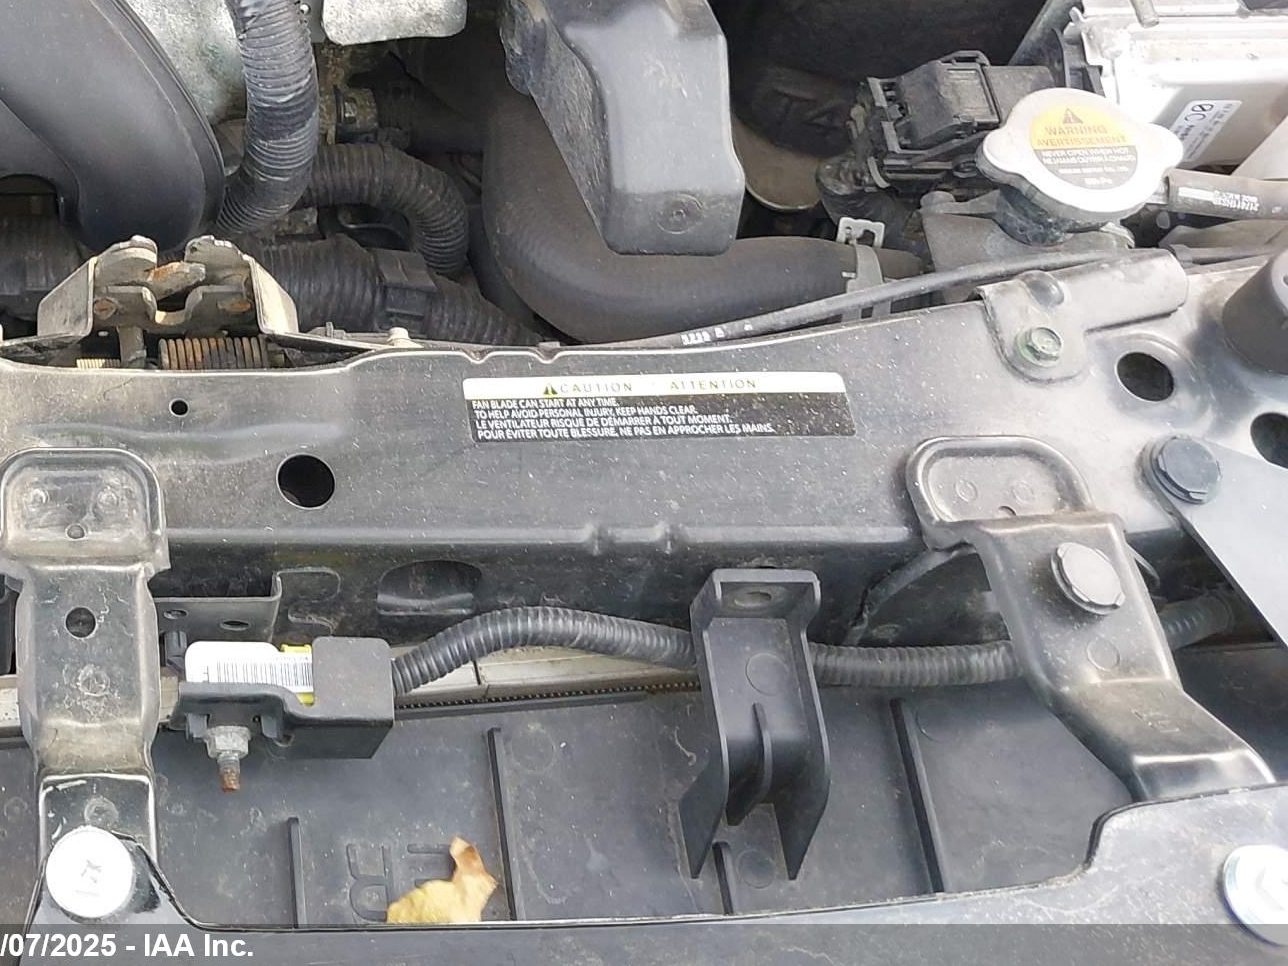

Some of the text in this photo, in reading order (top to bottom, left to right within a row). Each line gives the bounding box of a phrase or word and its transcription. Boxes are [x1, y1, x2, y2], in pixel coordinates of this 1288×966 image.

[1045, 125, 1108, 136] WARNING
[1037, 135, 1127, 147] AVERTISSEMENT
[560, 379, 757, 394] CAUTION ATTENTION
[472, 397, 620, 409] FAN BLADE CAN START AT ANY TIME.
[475, 410, 488, 420] TO
[488, 409, 510, 419] HELP
[511, 409, 539, 419] AVOID
[539, 408, 583, 418] PERSONAL
[615, 407, 637, 417] KEEP
[638, 406, 668, 416] HANDS
[668, 405, 698, 415] CLEAR.
[476, 414, 733, 430] LE VENTILATEUR RISQUE DE DÉMARRER À TOUT MOMENT.
[478, 429, 505, 440] POUR
[506, 427, 538, 439] ÉVITER
[539, 429, 570, 439] TOUTE
[619, 427, 633, 437] NE
[634, 427, 652, 436] PAS
[652, 426, 666, 436] EN
[667, 425, 723, 436] APPROCHER
[724, 425, 741, 434] LES
[742, 424, 776, 434] MAINS.
